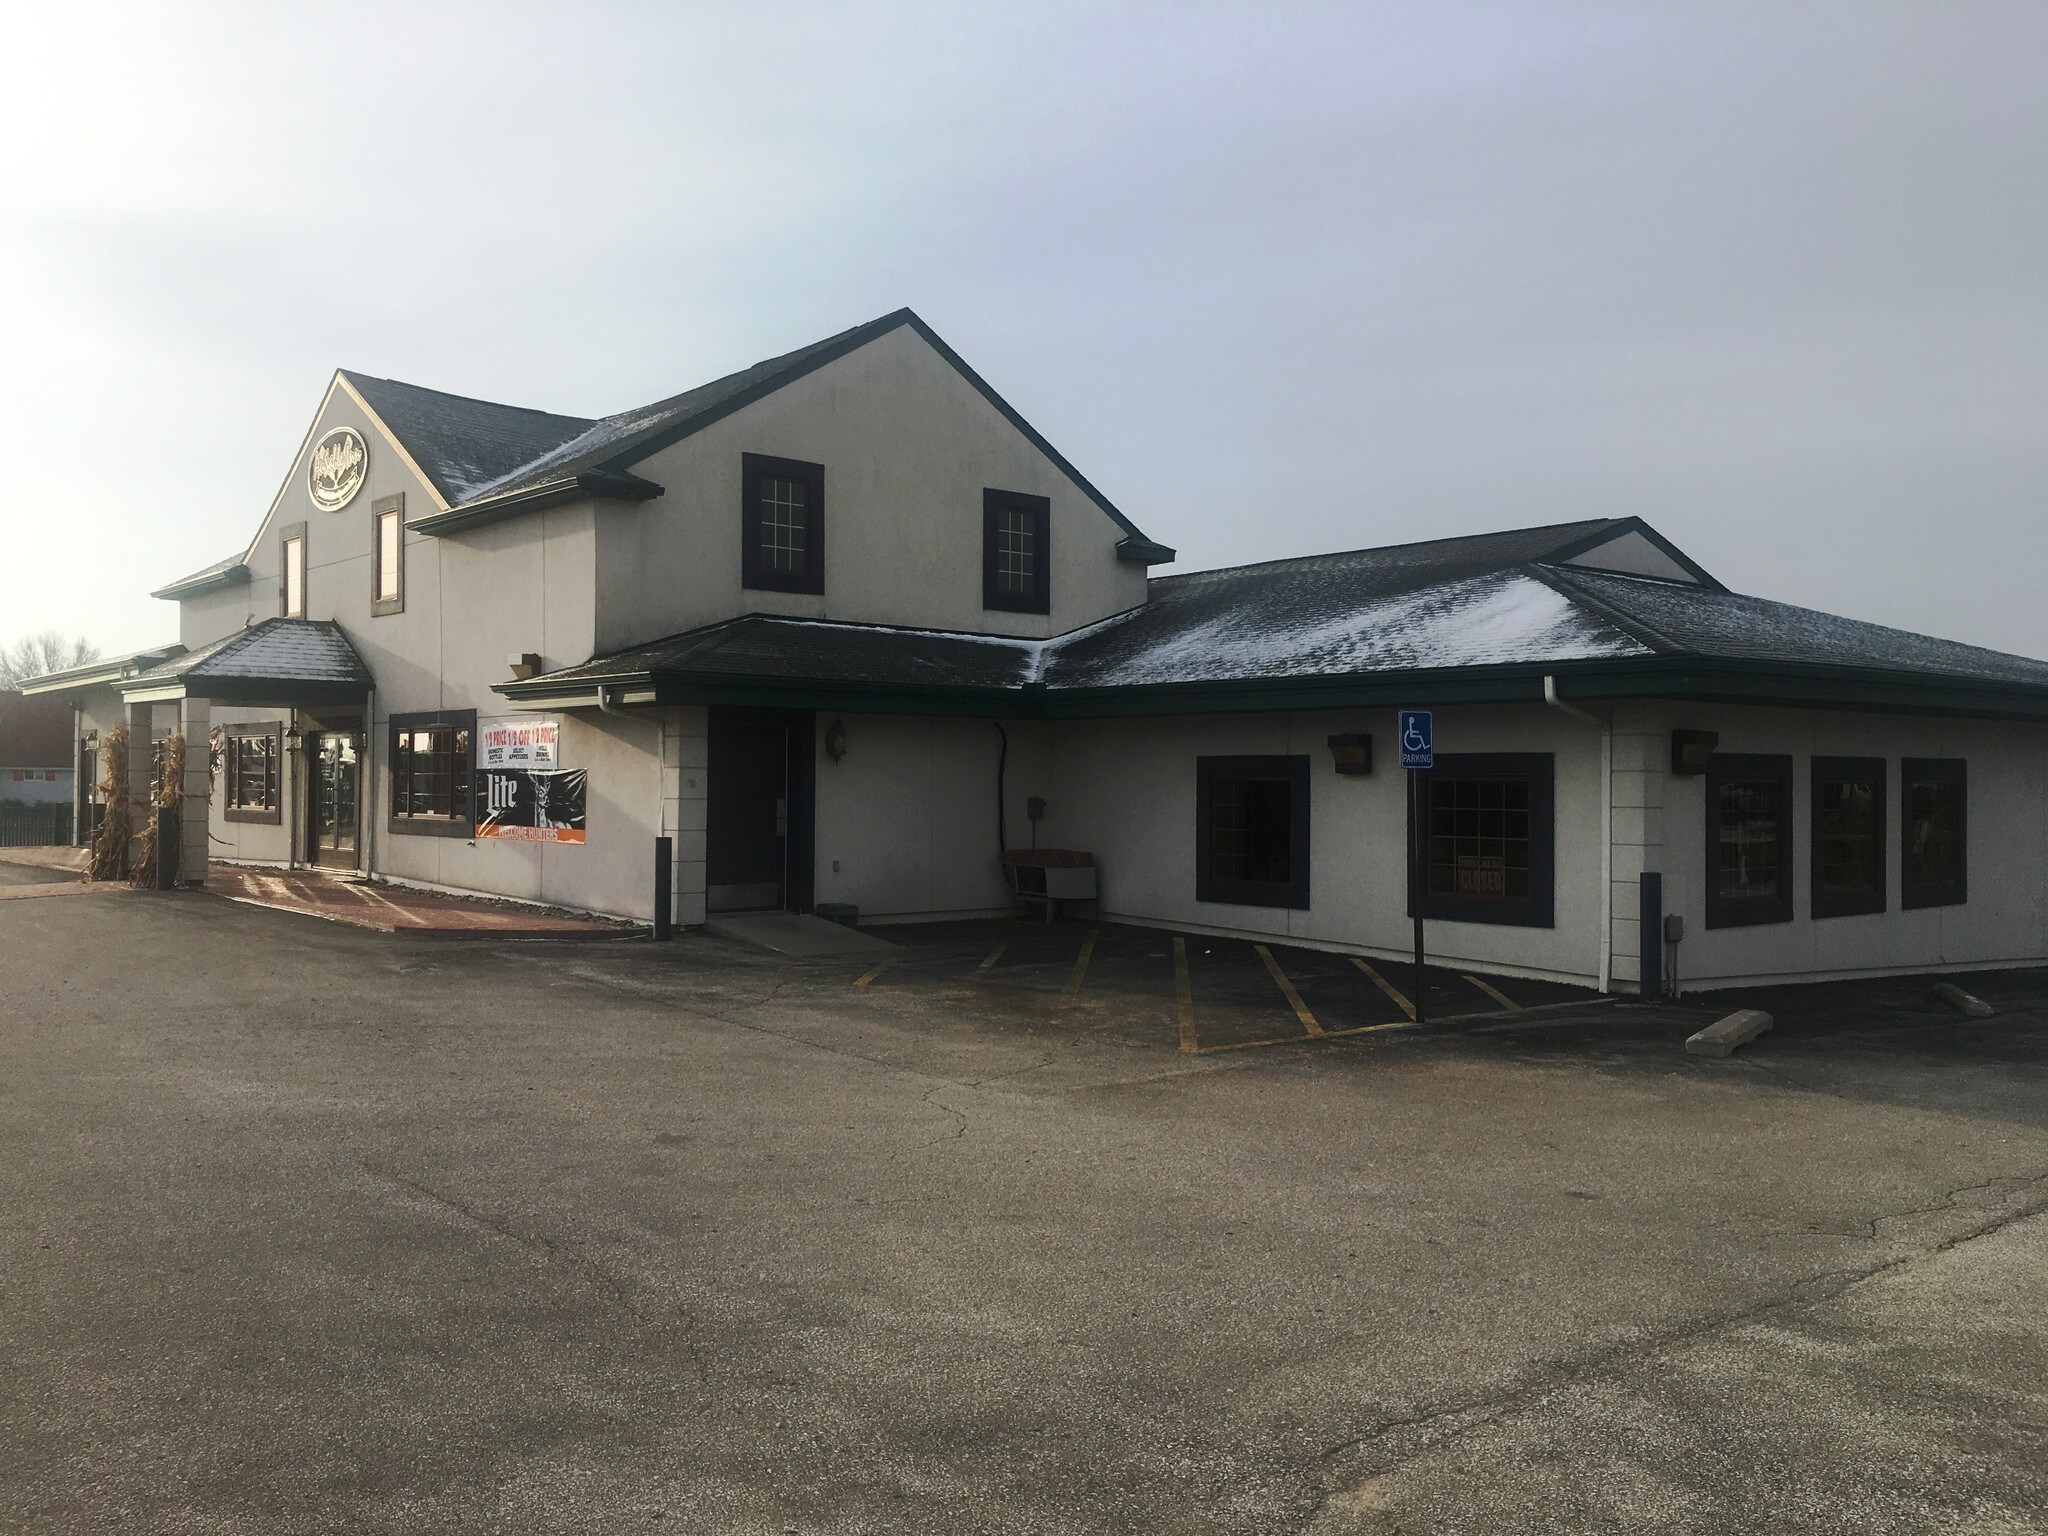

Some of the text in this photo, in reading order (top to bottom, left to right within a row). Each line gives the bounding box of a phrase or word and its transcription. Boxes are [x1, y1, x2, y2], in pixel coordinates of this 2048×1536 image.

[518, 730, 530, 746] OFF
[1402, 753, 1431, 763] PARKING
[486, 774, 517, 816] Lite
[499, 825, 558, 840] WELCOME HUNTERS
[1461, 870, 1501, 891] CLOSED
